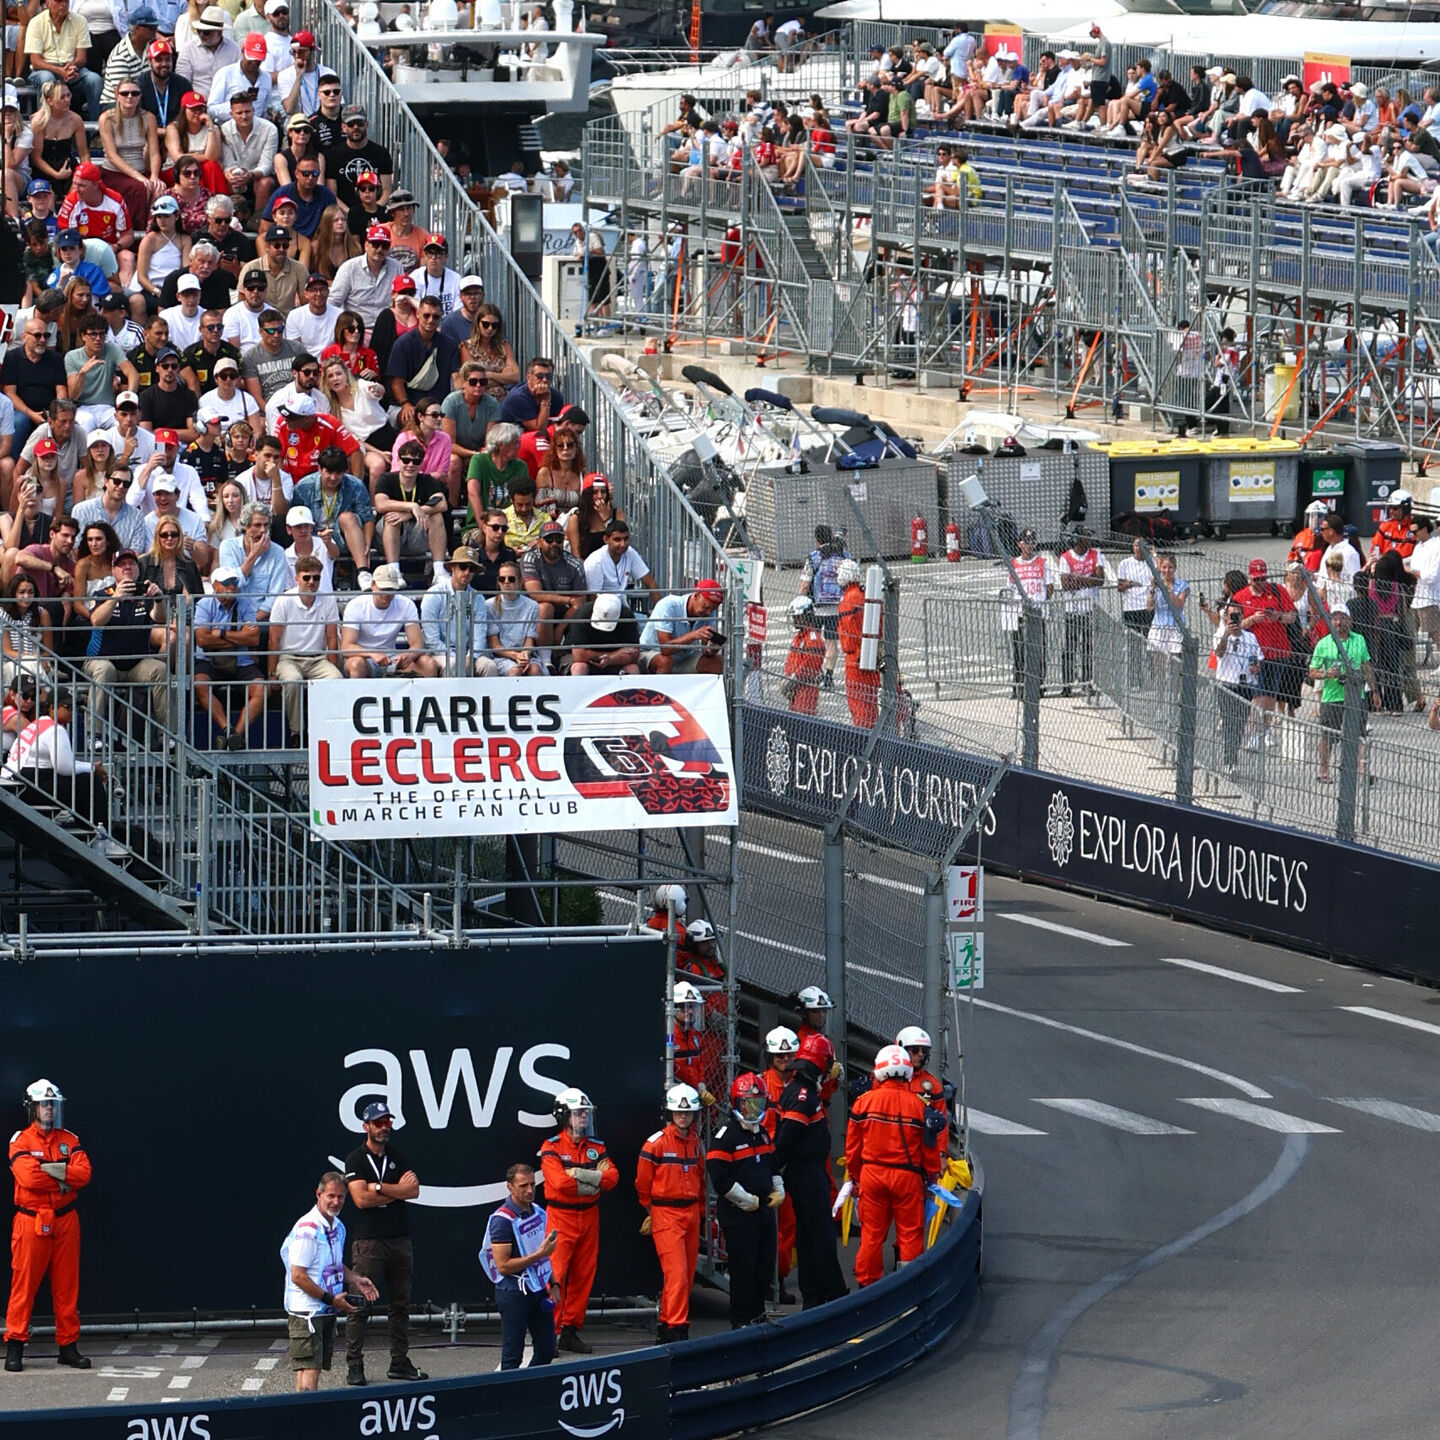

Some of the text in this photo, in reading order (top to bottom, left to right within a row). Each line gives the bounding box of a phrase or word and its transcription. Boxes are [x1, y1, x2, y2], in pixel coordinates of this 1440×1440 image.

[257, 357, 296, 374] RAMON
[352, 693, 562, 734] CHARLES
[318, 736, 561, 787] LECLERC
[342, 800, 579, 822] MARCHE FAN CLUB
[373, 787, 546, 804] THE OFFICIAL
[1080, 810, 1309, 913] EXPLORA JOURNEYS
[955, 968, 981, 976] EXT
[339, 1044, 572, 1133] aws
[561, 1370, 622, 1411] aws
[361, 1396, 436, 1436] aws
